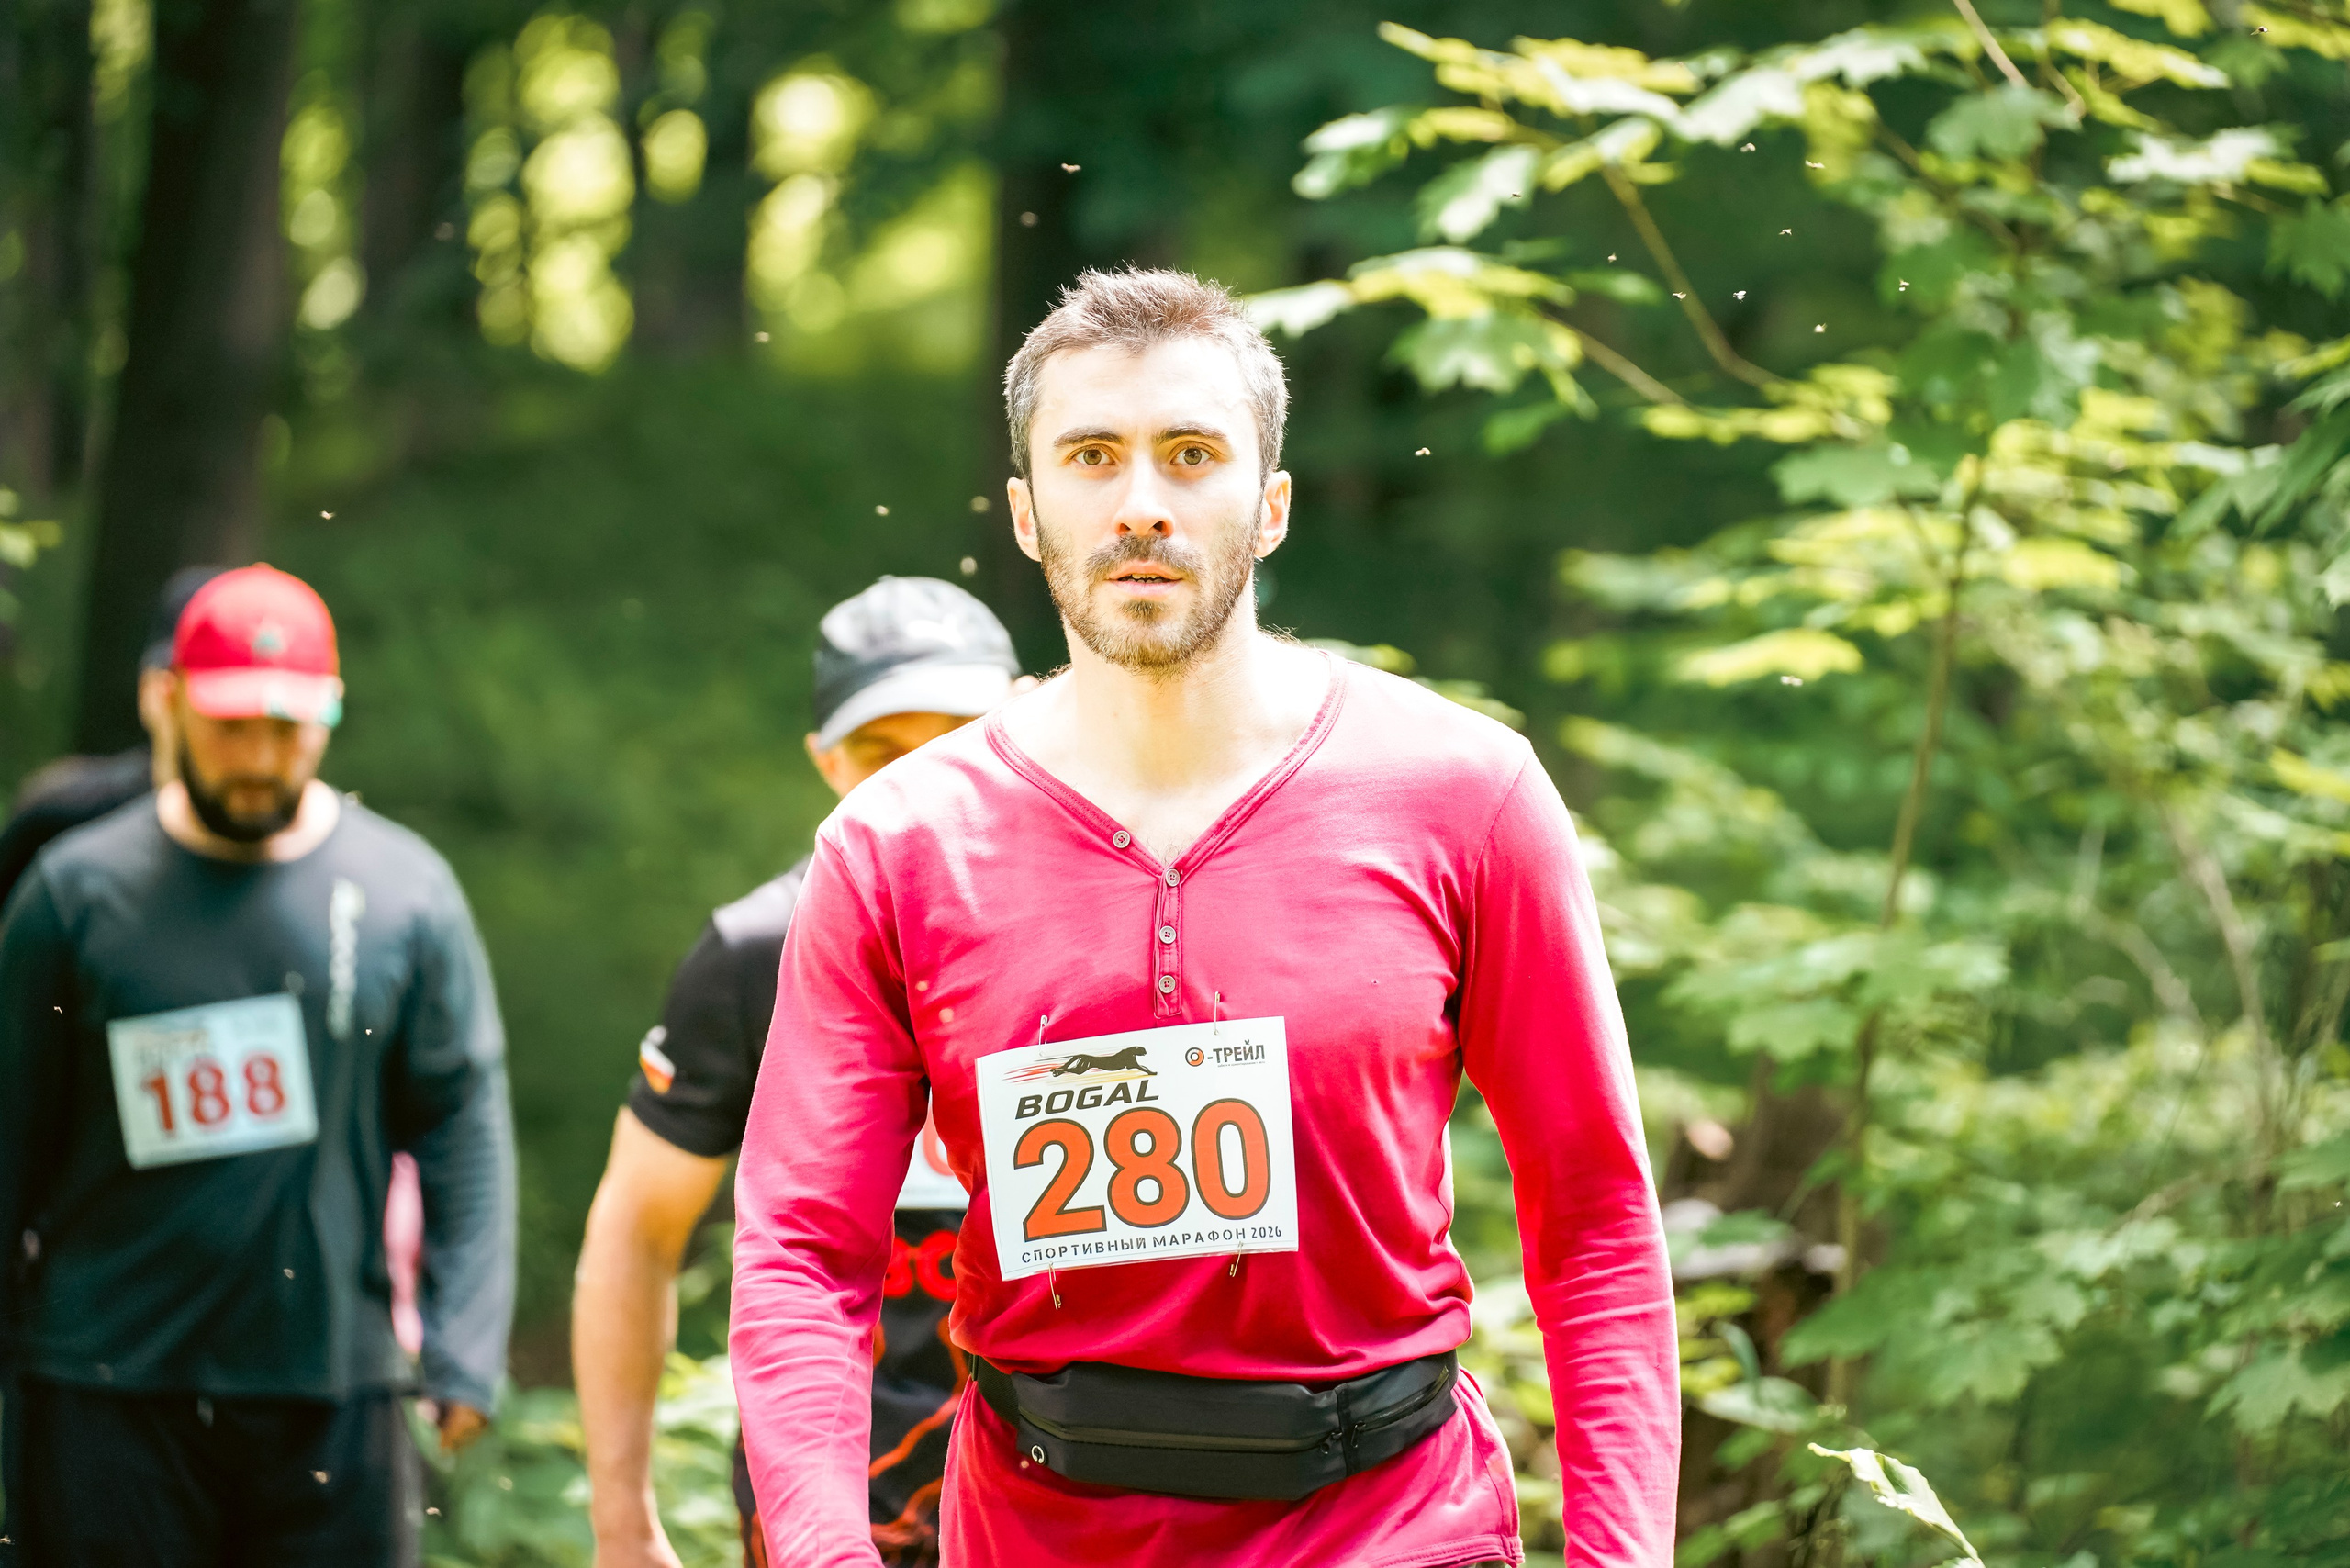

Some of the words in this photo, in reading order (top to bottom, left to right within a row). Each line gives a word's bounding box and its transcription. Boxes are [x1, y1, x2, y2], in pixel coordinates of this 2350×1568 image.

[140, 1052, 287, 1137] 188
[1015, 1080, 1158, 1120] BOGAL
[1013, 1097, 1271, 1242] 280
[1022, 1237, 1147, 1263] СПОРТИВНЫЙ
[1152, 1227, 1246, 1248] МАРАФОН
[1250, 1226, 1282, 1239] 2026
